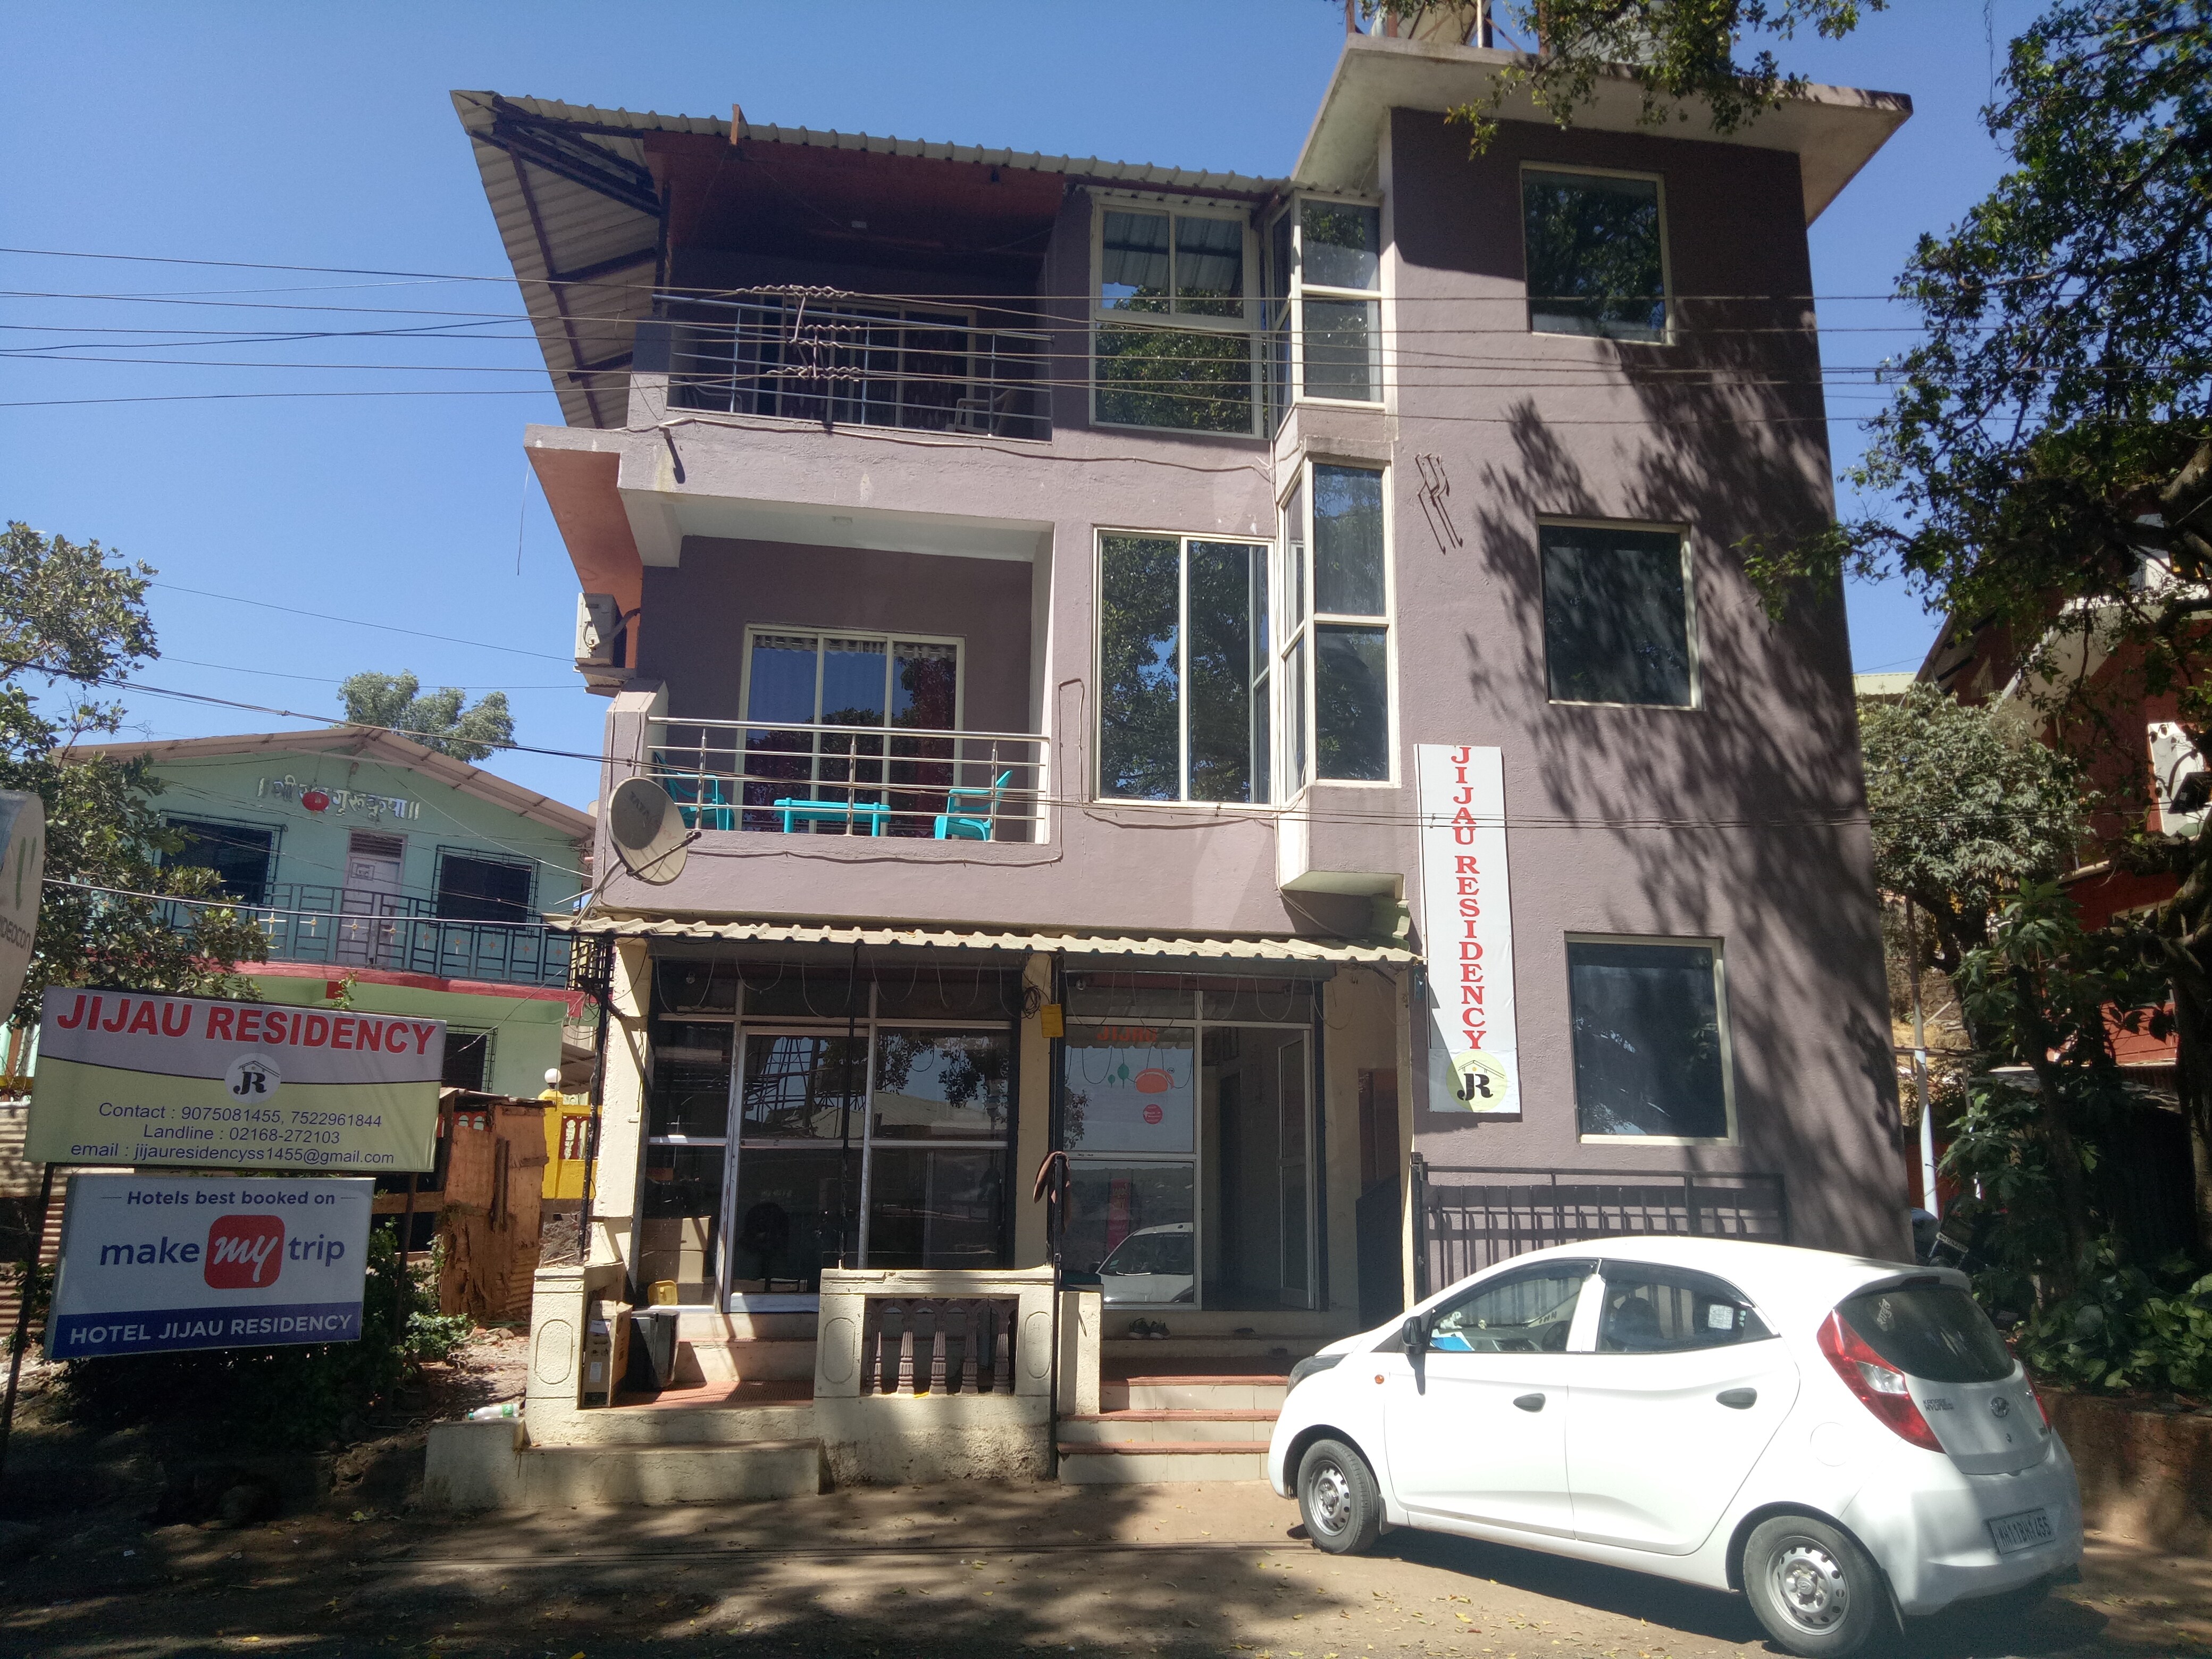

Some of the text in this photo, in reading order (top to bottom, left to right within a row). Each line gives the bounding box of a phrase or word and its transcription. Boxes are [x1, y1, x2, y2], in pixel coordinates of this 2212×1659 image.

[1451, 747, 1487, 1049] JIJAU RESIDENCY
[57, 994, 437, 1055] JIJAU RESIDENCY
[233, 1071, 267, 1095] JR
[1457, 1073, 1493, 1101] JR
[99, 1102, 166, 1118] Contact
[181, 1107, 284, 1125] 9075081455,
[291, 1111, 382, 1127] 7522961844
[144, 1124, 214, 1139] Landline
[229, 1127, 340, 1143] 02168-272103
[71, 1143, 119, 1157] email
[133, 1144, 394, 1165] jijauresidencyss1455@gmail.com
[127, 1191, 335, 1204] Hotels best booked on
[99, 1234, 345, 1283] make my trip
[70, 1314, 353, 1345] HOTEL JIJAU RESIDENCY
